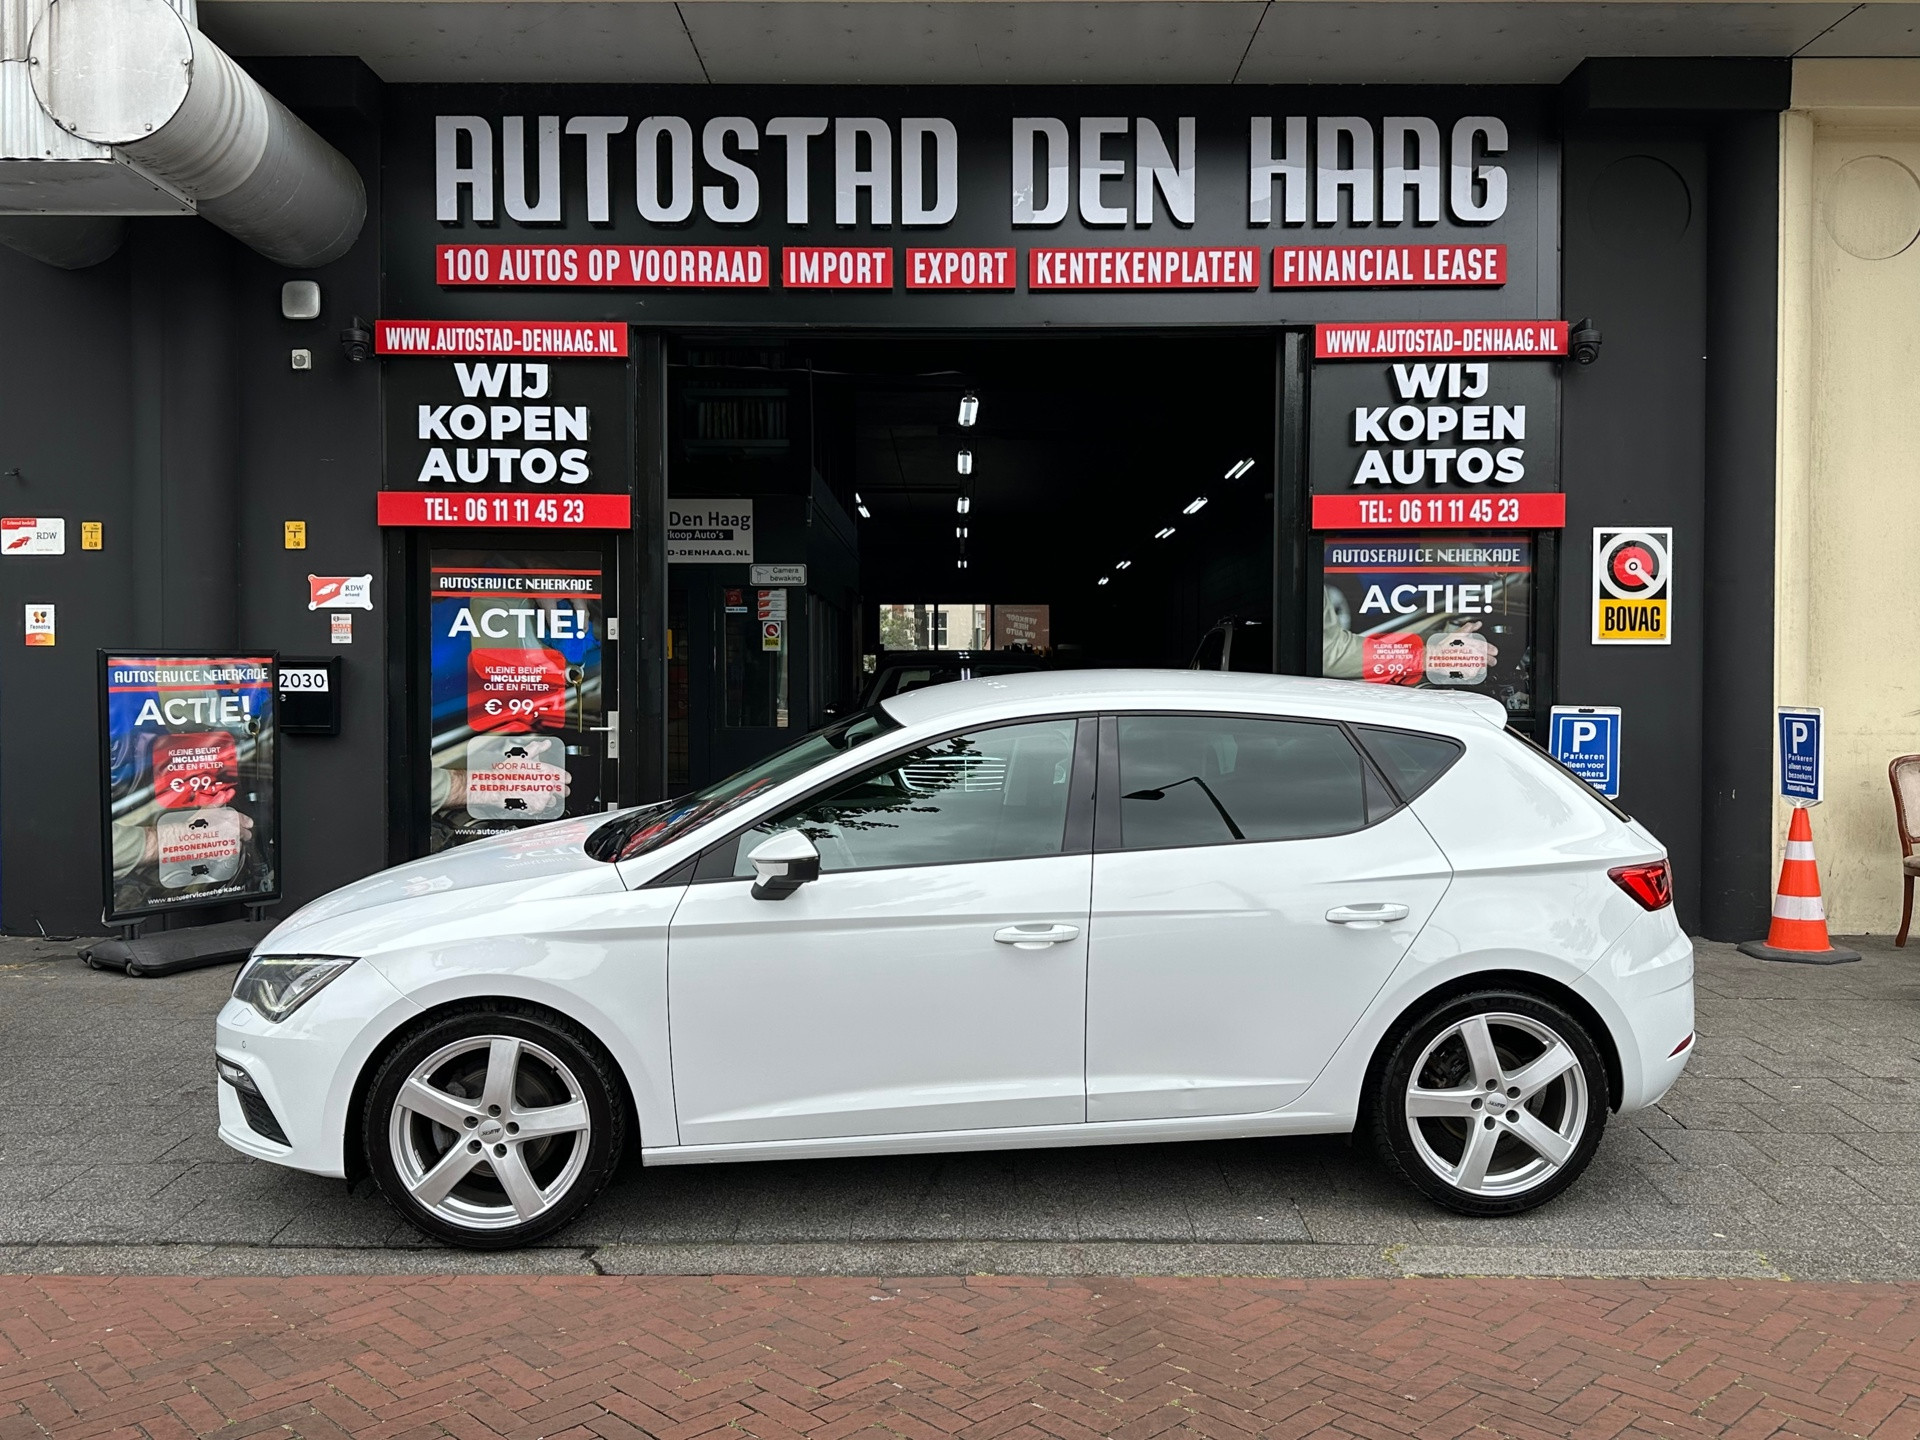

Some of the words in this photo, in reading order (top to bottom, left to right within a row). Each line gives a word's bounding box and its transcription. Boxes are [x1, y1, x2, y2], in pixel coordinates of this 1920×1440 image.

[436, 115, 958, 225] AUTOSTAD
[1012, 116, 1196, 225] DEN
[1249, 116, 1509, 223] HAAG
[444, 248, 489, 282] 100
[499, 248, 579, 282] AUTOS
[586, 249, 620, 282] OP
[629, 249, 762, 284] VOORRAAD
[789, 251, 886, 284] IMPORT
[914, 252, 1009, 284] EXPORT
[1036, 251, 1253, 284] KENTEKENPLATEN
[1284, 249, 1413, 283] FINANCIAL
[1423, 247, 1498, 281] LEASE
[385, 327, 618, 353] WWW.AUTOSTAD-DENHAAG.NL
[1325, 327, 1558, 354] WWW.AUTOSTAD-DENHAAG.NL
[453, 362, 549, 399] WIJ
[1392, 362, 1489, 399] WIJ
[418, 404, 588, 441] KOPEN
[1355, 404, 1526, 442] KOPEN
[417, 447, 590, 485] AUTOS
[1353, 447, 1525, 485] AUTOS
[424, 497, 458, 521] TEL:
[465, 498, 488, 522] 06
[492, 498, 509, 522] 11
[513, 499, 530, 522] 11
[534, 499, 558, 523] 45
[563, 499, 585, 523] 23
[1359, 500, 1393, 523] TEL:
[1399, 499, 1422, 523] 06
[1427, 499, 1443, 523] 11
[1448, 499, 1464, 522] 11
[1469, 499, 1492, 522] 45
[1497, 498, 1519, 522] 23
[669, 511, 703, 527] Den
[708, 511, 751, 530] Haag
[36, 532, 58, 540] RDW
[694, 530, 724, 540] Auto's
[1437, 548, 1521, 563] NEHERKADE
[345, 584, 364, 592] RDW
[525, 577, 594, 591] NEHERKADE
[770, 575, 802, 583] bewaking
[1358, 584, 1494, 615] ACTIE!
[448, 607, 586, 640] ACTIE!
[1604, 605, 1661, 632] BOVAG
[202, 667, 269, 682] NEHERKADE
[485, 666, 516, 675] KLEINE
[517, 666, 548, 675] BEURT
[490, 674, 543, 683] INCLUSIEF
[280, 673, 325, 689] 2030
[483, 683, 505, 692] OLIE
[505, 683, 518, 691] EN
[520, 683, 550, 692] FILTER
[134, 695, 253, 726] ACTIE!
[484, 699, 503, 716] €
[508, 698, 549, 718] 99,-
[1573, 721, 1597, 753] P
[1792, 721, 1809, 754] P
[168, 748, 194, 757] KLEINE
[195, 746, 221, 755] BEURT
[172, 754, 218, 764] INCLUSIEF
[1563, 752, 1605, 760] Parkeren
[1787, 753, 1813, 763] Parkeren
[167, 763, 185, 771] OLIE
[186, 762, 198, 771] EN
[200, 761, 224, 770] FILTER
[491, 762, 518, 771] VOOR
[519, 762, 542, 771] ALLE
[1576, 770, 1605, 778] oekers
[169, 778, 185, 793] €
[189, 776, 223, 792] 99,-
[471, 773, 561, 782] PERSONENAUTO'S
[470, 784, 478, 792] &
[479, 784, 562, 793] BEDRIJFSAUTO'S
[178, 832, 202, 842] VOOR
[202, 830, 220, 839] ALLE
[162, 838, 236, 854] PERSONENAUTO'S
[170, 848, 238, 863] BEDRIJFSAUTO'S
